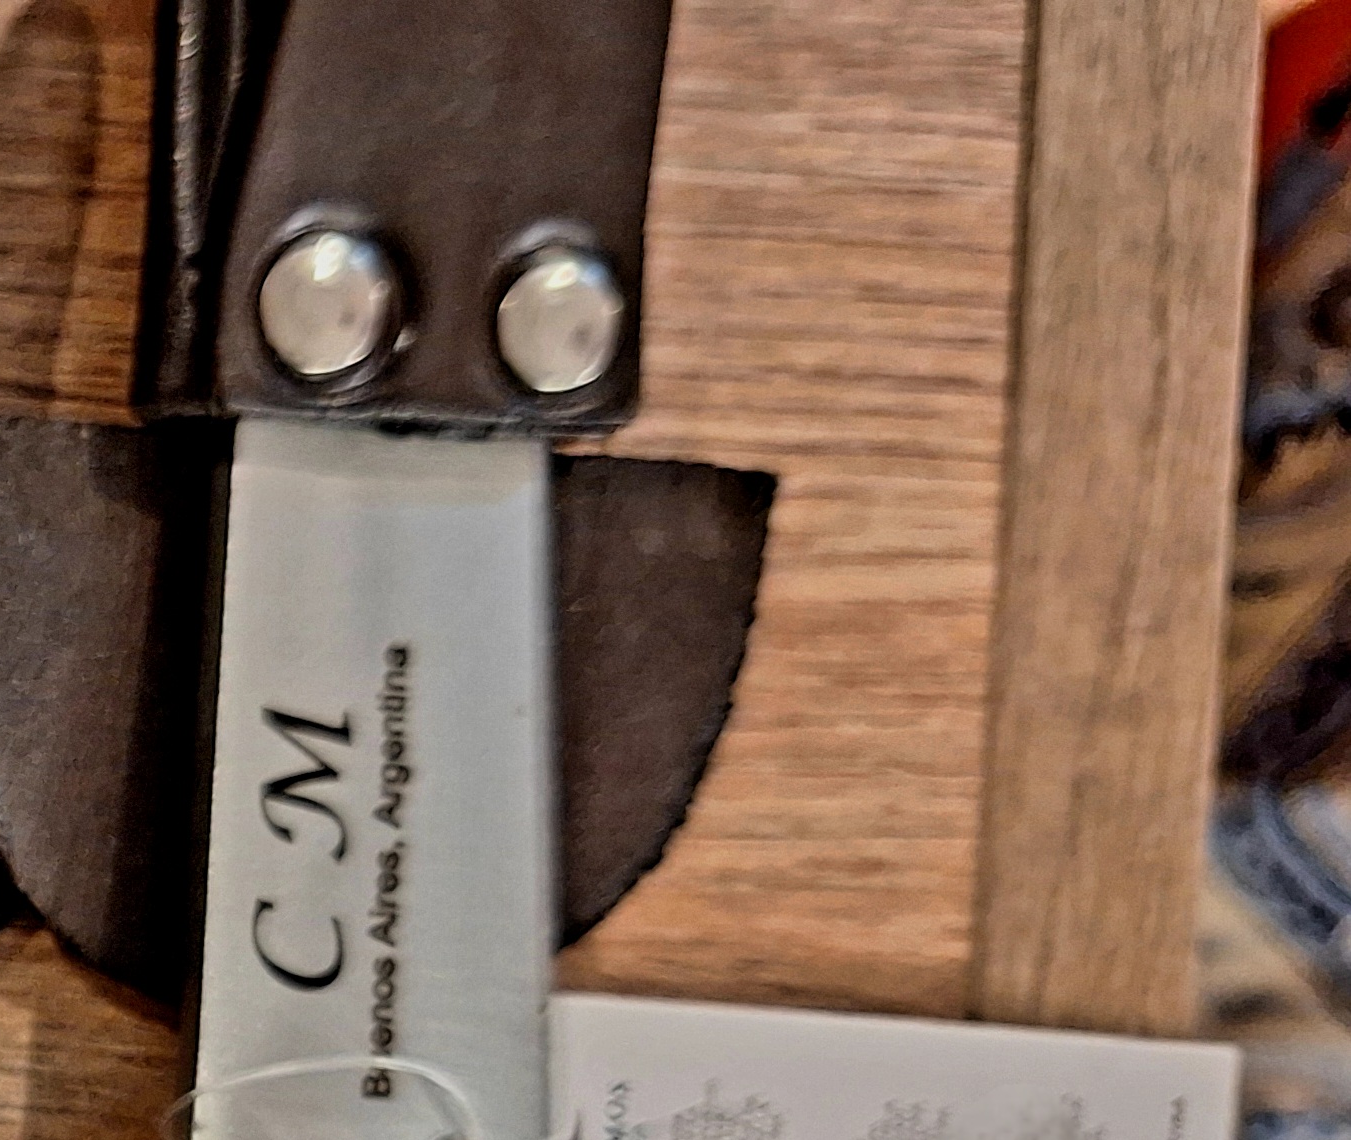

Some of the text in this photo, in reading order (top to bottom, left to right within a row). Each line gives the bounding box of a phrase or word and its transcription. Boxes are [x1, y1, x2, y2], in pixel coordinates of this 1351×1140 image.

[374, 643, 412, 828] Argentina
[252, 707, 352, 990] C M
[368, 841, 405, 946] Aires,
